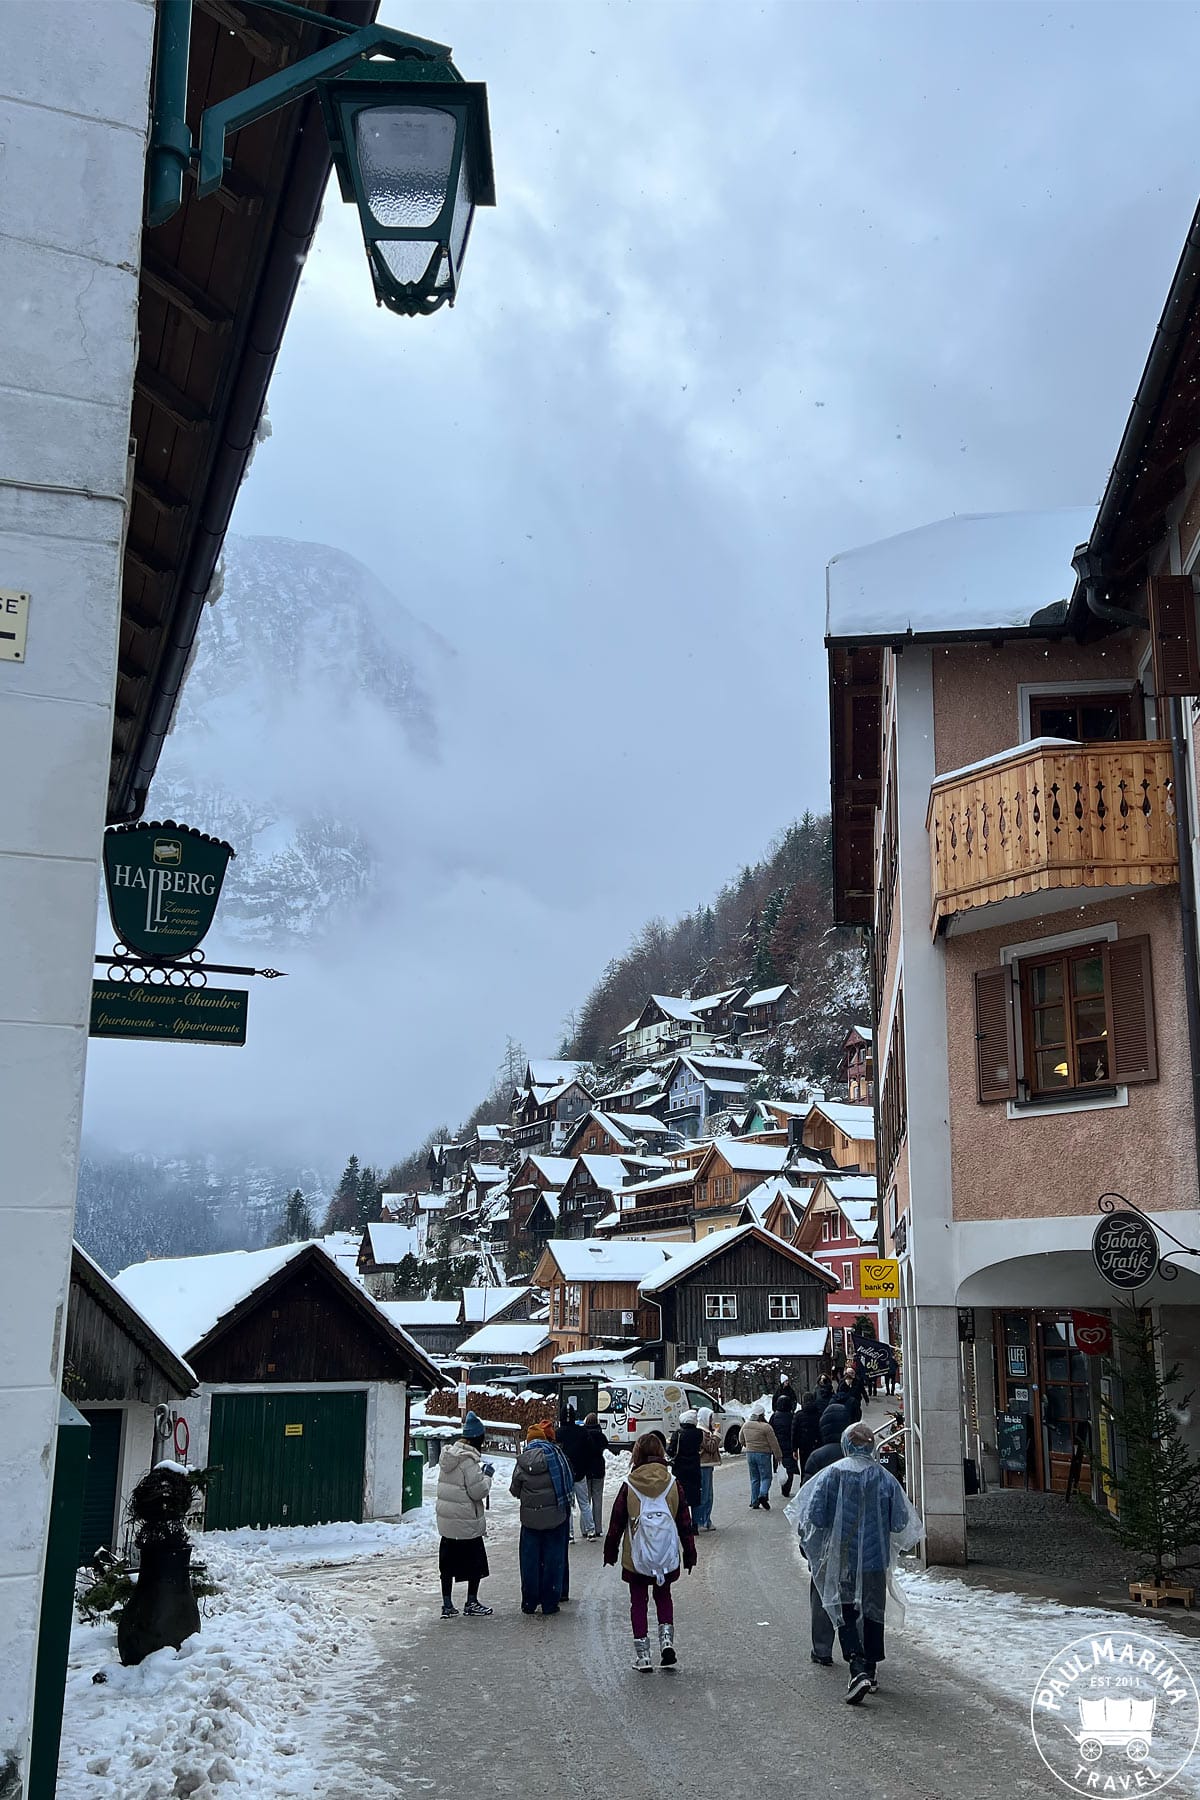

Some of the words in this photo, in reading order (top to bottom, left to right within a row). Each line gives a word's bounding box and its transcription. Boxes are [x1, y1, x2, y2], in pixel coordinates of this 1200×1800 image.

[0, 598, 19, 614] E
[162, 900, 200, 915] Zimmer
[169, 917, 200, 927] rooms
[157, 924, 199, 937] chambres
[127, 986, 175, 1003] Rooms
[183, 991, 241, 1010] Chambre
[1100, 1227, 1152, 1251] Tabak
[1101, 1250, 1153, 1272] Trafik
[864, 1283, 882, 1291] bank
[882, 1282, 895, 1292] 99
[1010, 1347, 1025, 1362] LIFE
